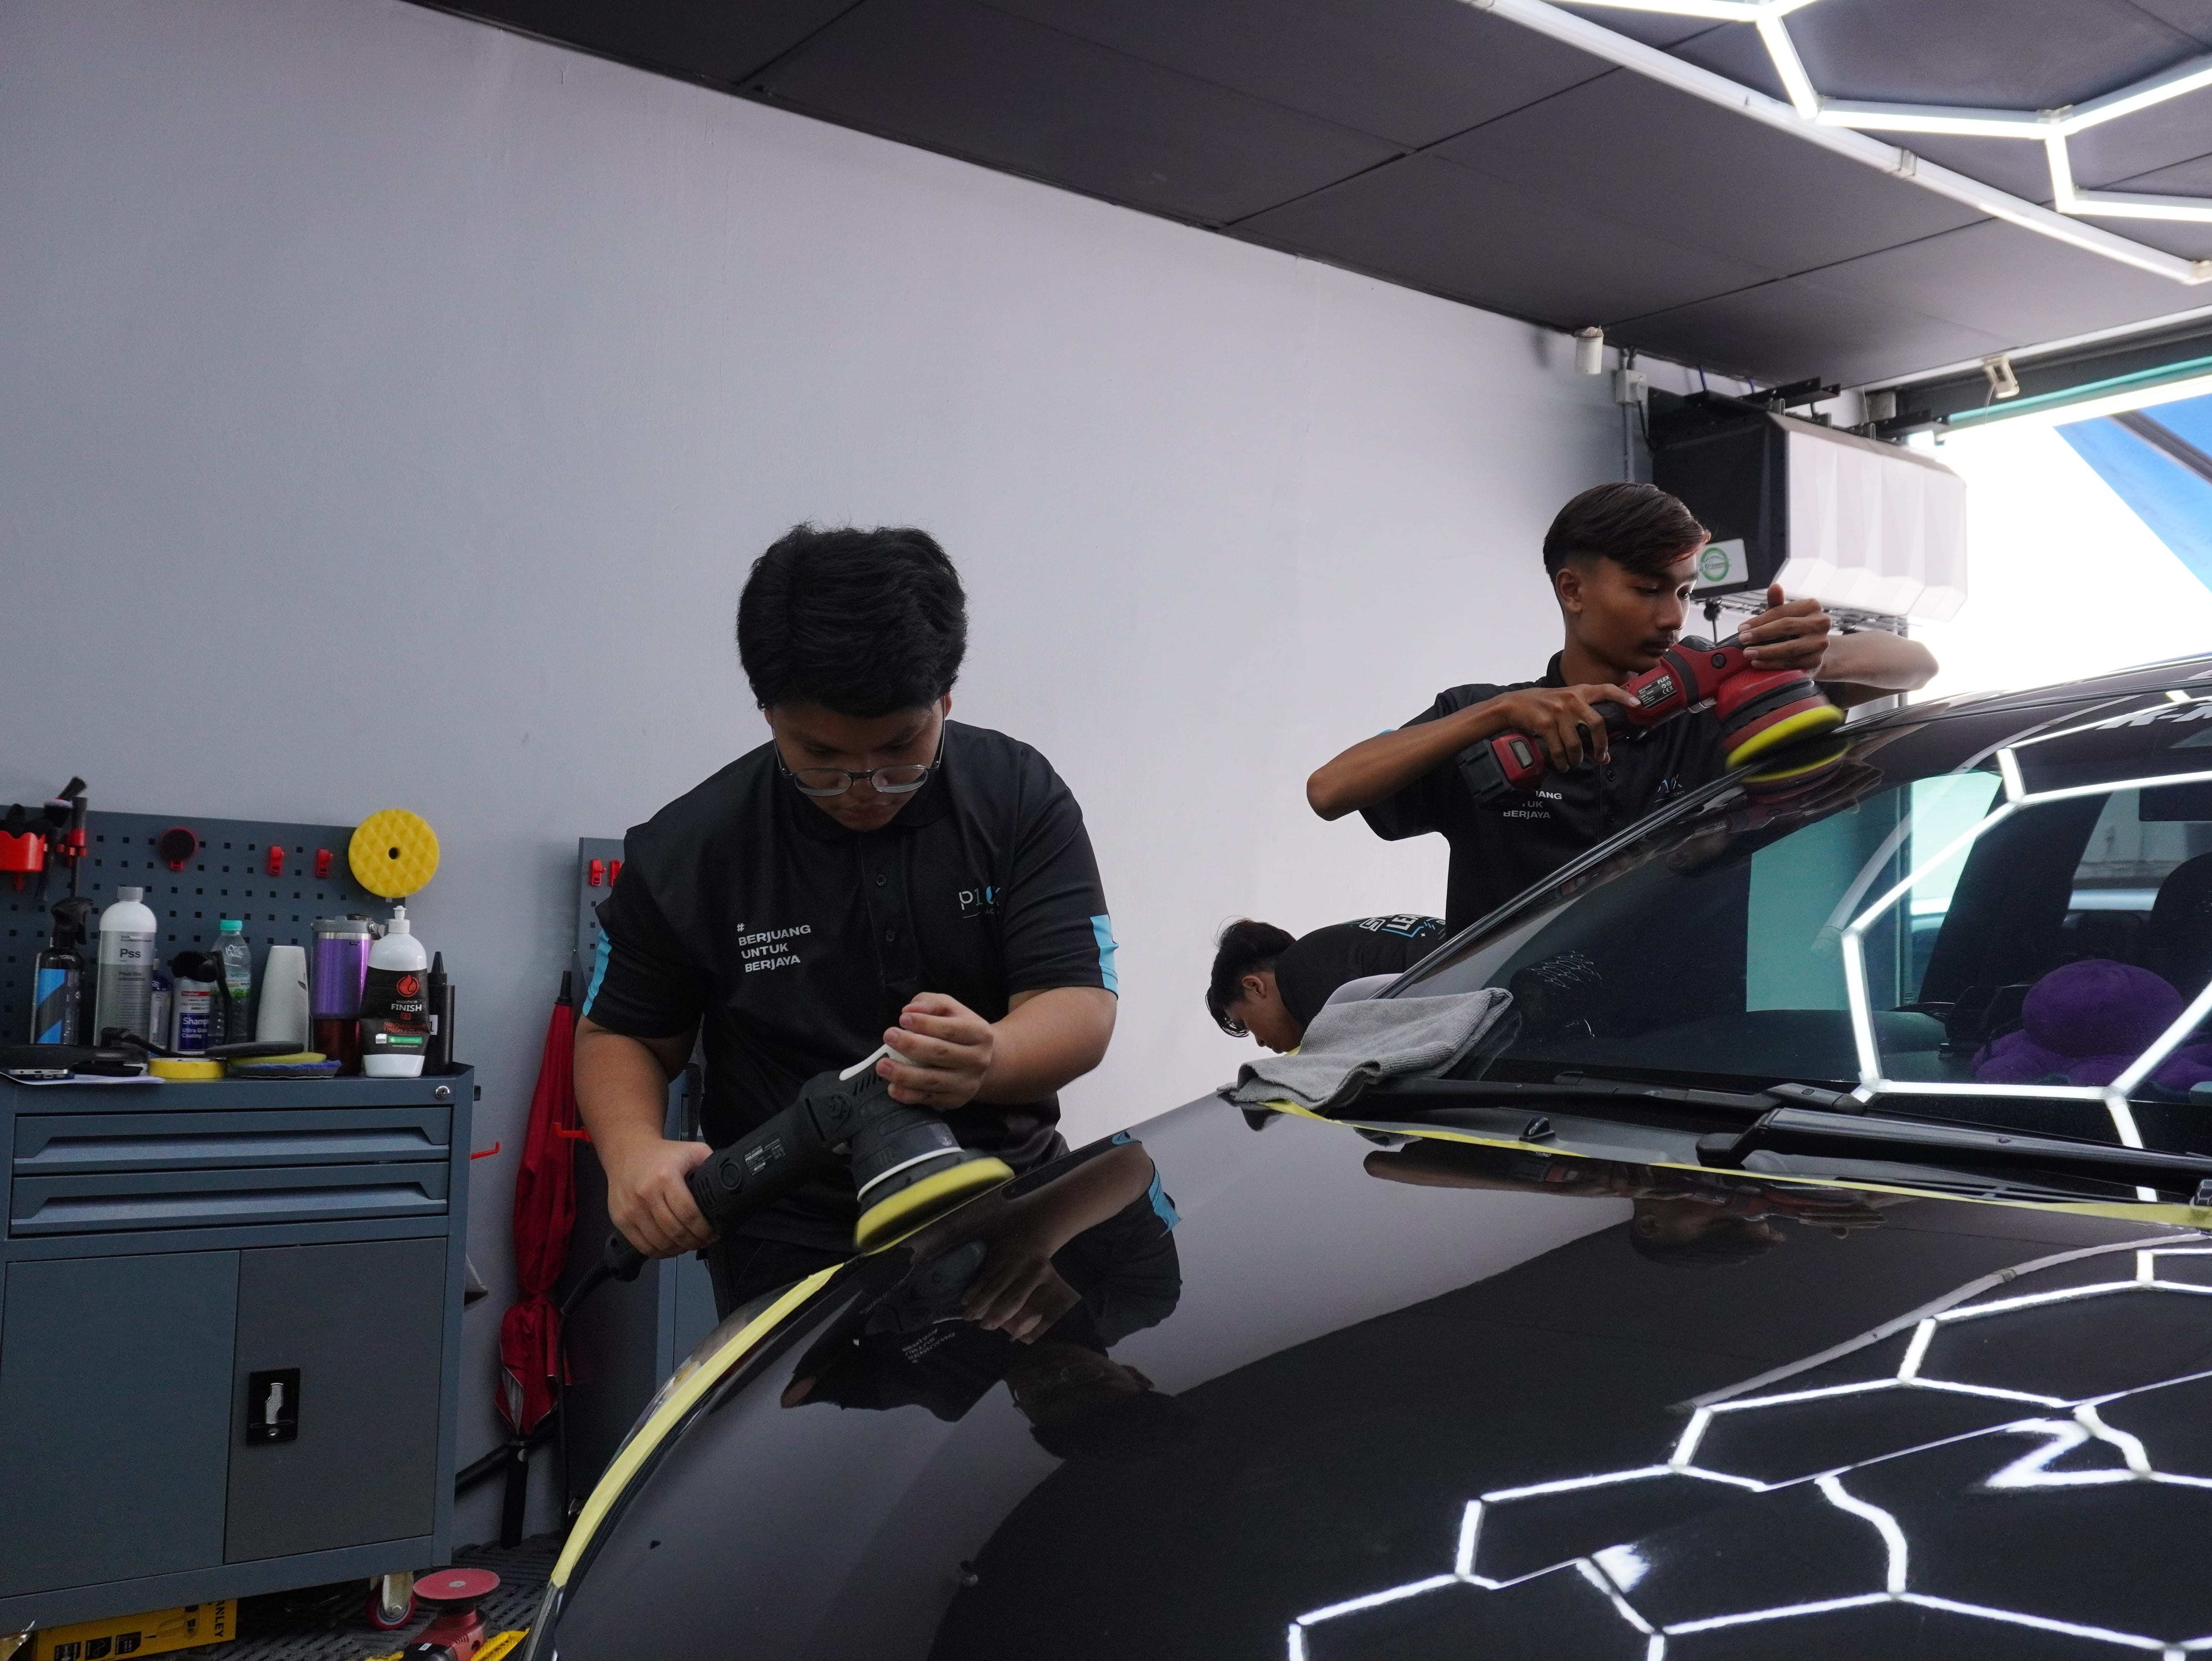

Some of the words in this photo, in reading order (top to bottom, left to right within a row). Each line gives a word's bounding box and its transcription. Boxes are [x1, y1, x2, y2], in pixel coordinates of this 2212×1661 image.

[1657, 675, 1670, 684] FLEX
[1503, 810, 1551, 819] BERJAYA
[738, 925, 811, 946] BERJUANG
[120, 948, 141, 958] Pss
[741, 943, 788, 959] UNTUK
[745, 955, 800, 973] BERJAYA
[391, 1003, 422, 1012] FINISH
